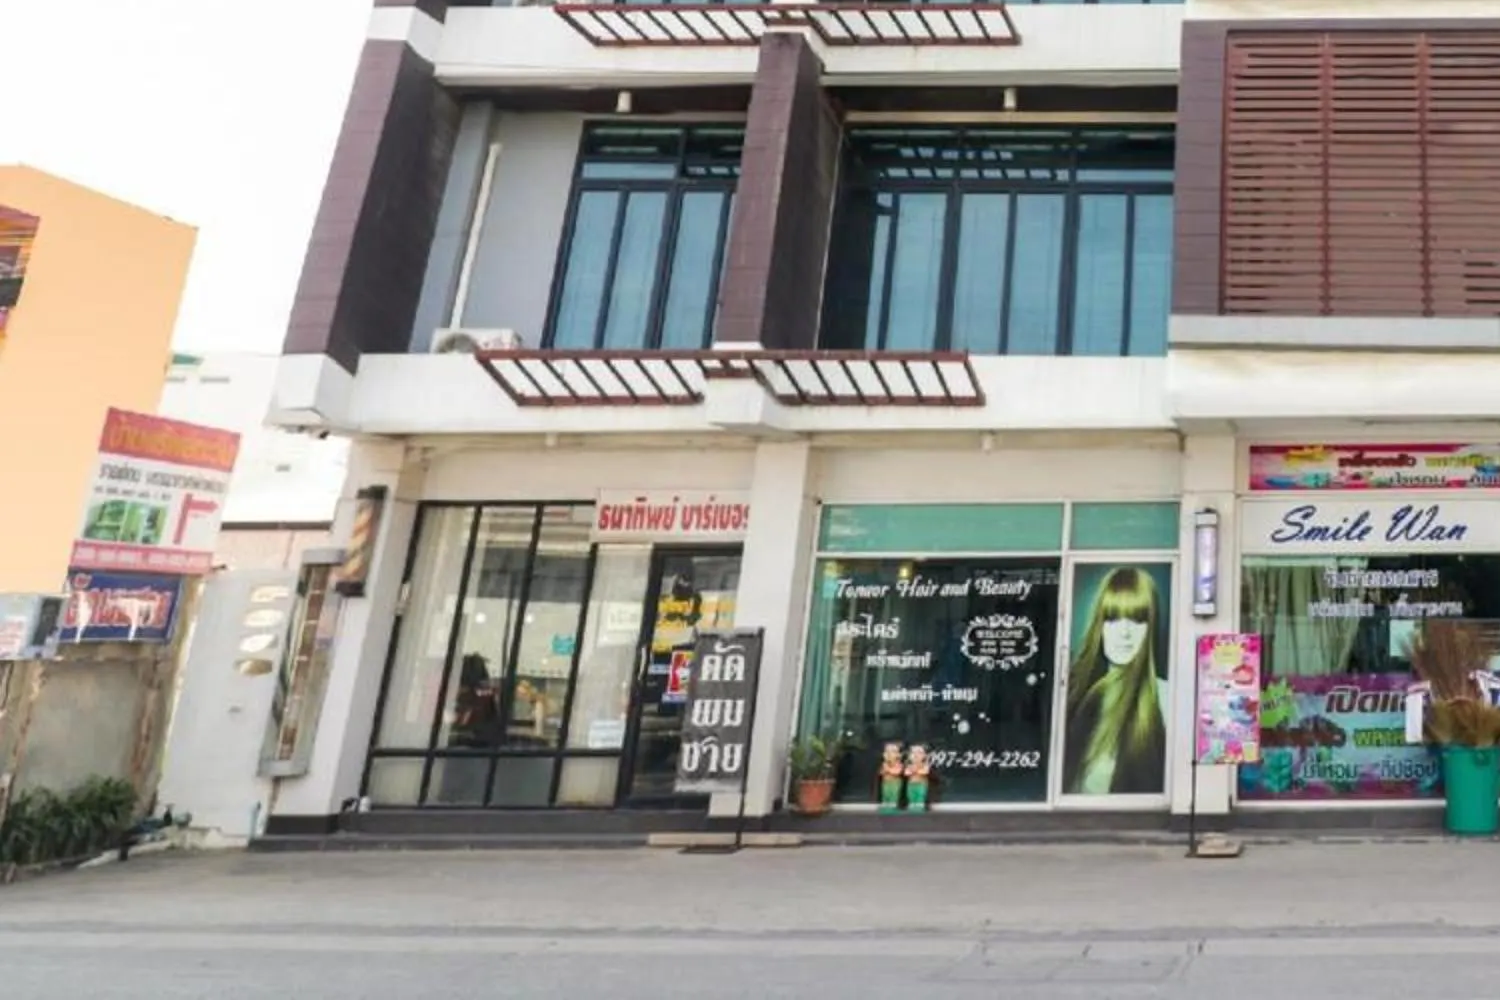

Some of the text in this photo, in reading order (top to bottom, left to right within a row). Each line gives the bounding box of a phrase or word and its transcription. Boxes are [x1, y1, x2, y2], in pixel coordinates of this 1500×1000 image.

[1271, 504, 1468, 543] Smile Wan
[896, 574, 939, 598] Hair
[940, 577, 971, 597] and
[974, 577, 1032, 601] Beauty
[700, 641, 746, 681] ตัด
[691, 699, 745, 728] ผม
[680, 735, 743, 773] ชาย
